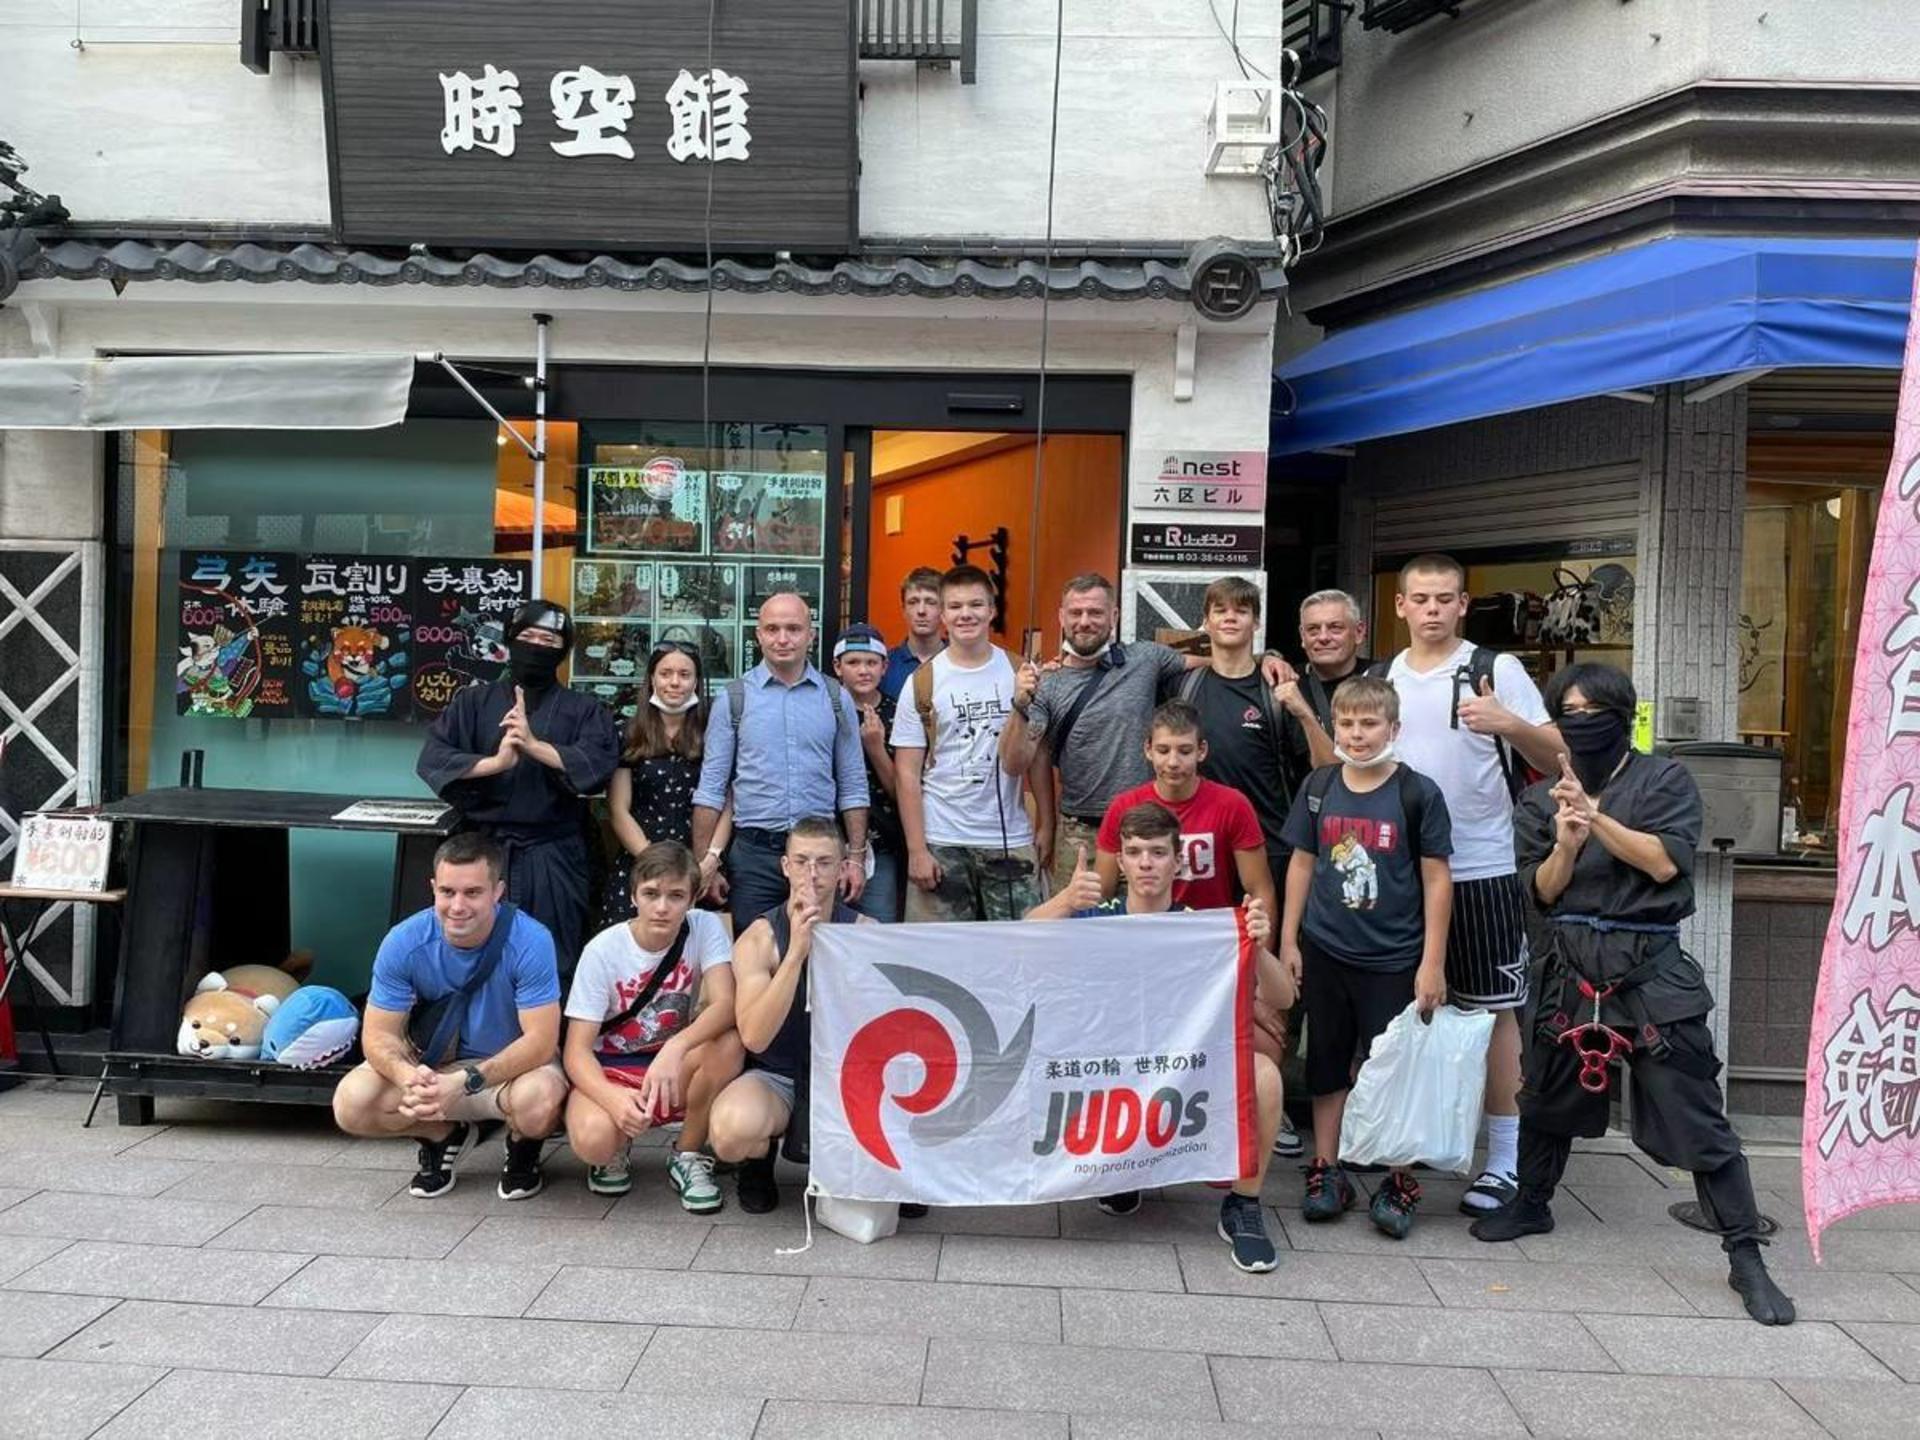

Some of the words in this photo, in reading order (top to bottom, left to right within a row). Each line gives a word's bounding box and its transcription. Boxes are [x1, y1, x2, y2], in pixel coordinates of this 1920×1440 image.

[438, 63, 751, 162] 時空館
[1183, 460, 1241, 477] nest
[1153, 487, 1242, 505] 六区ビル
[191, 555, 289, 595] 弓矢
[300, 561, 408, 596] 瓦割り
[422, 566, 524, 595] 手裏剣
[224, 596, 289, 618] 体験
[415, 671, 458, 688] ハズレ
[1046, 1057, 1121, 1079] 柔道の輪
[1134, 1051, 1208, 1075] 世界の輪
[1074, 1160, 1136, 1174] non-profit
